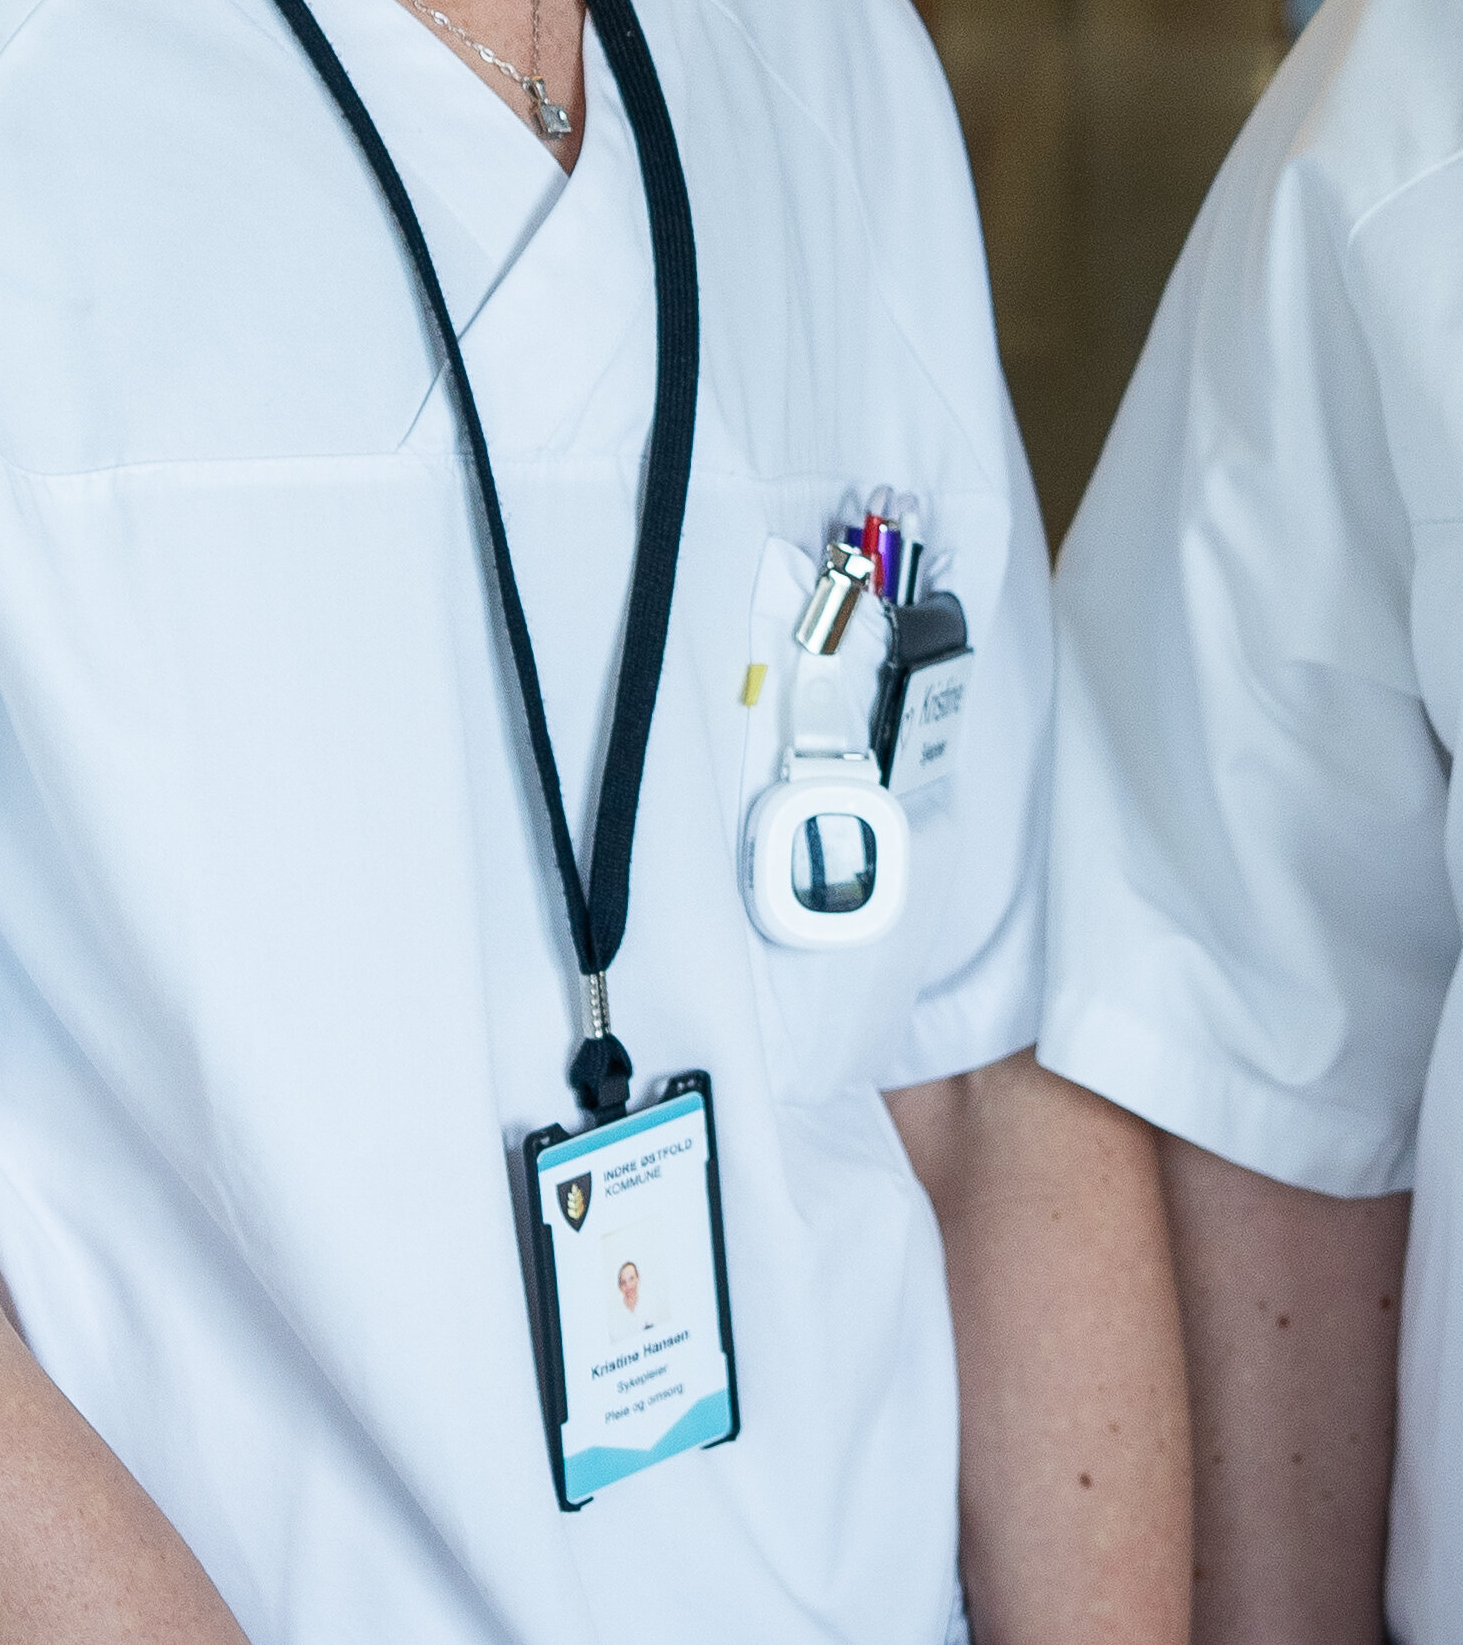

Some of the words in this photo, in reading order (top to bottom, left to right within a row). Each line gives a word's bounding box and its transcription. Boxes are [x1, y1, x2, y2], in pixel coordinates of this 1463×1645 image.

[603, 1160, 638, 1182] INDRE
[640, 1137, 693, 1167] ØSTFOLD
[605, 1165, 662, 1197] KOMMUNE
[591, 1351, 640, 1380] Kristine
[643, 1329, 690, 1357] Hansen
